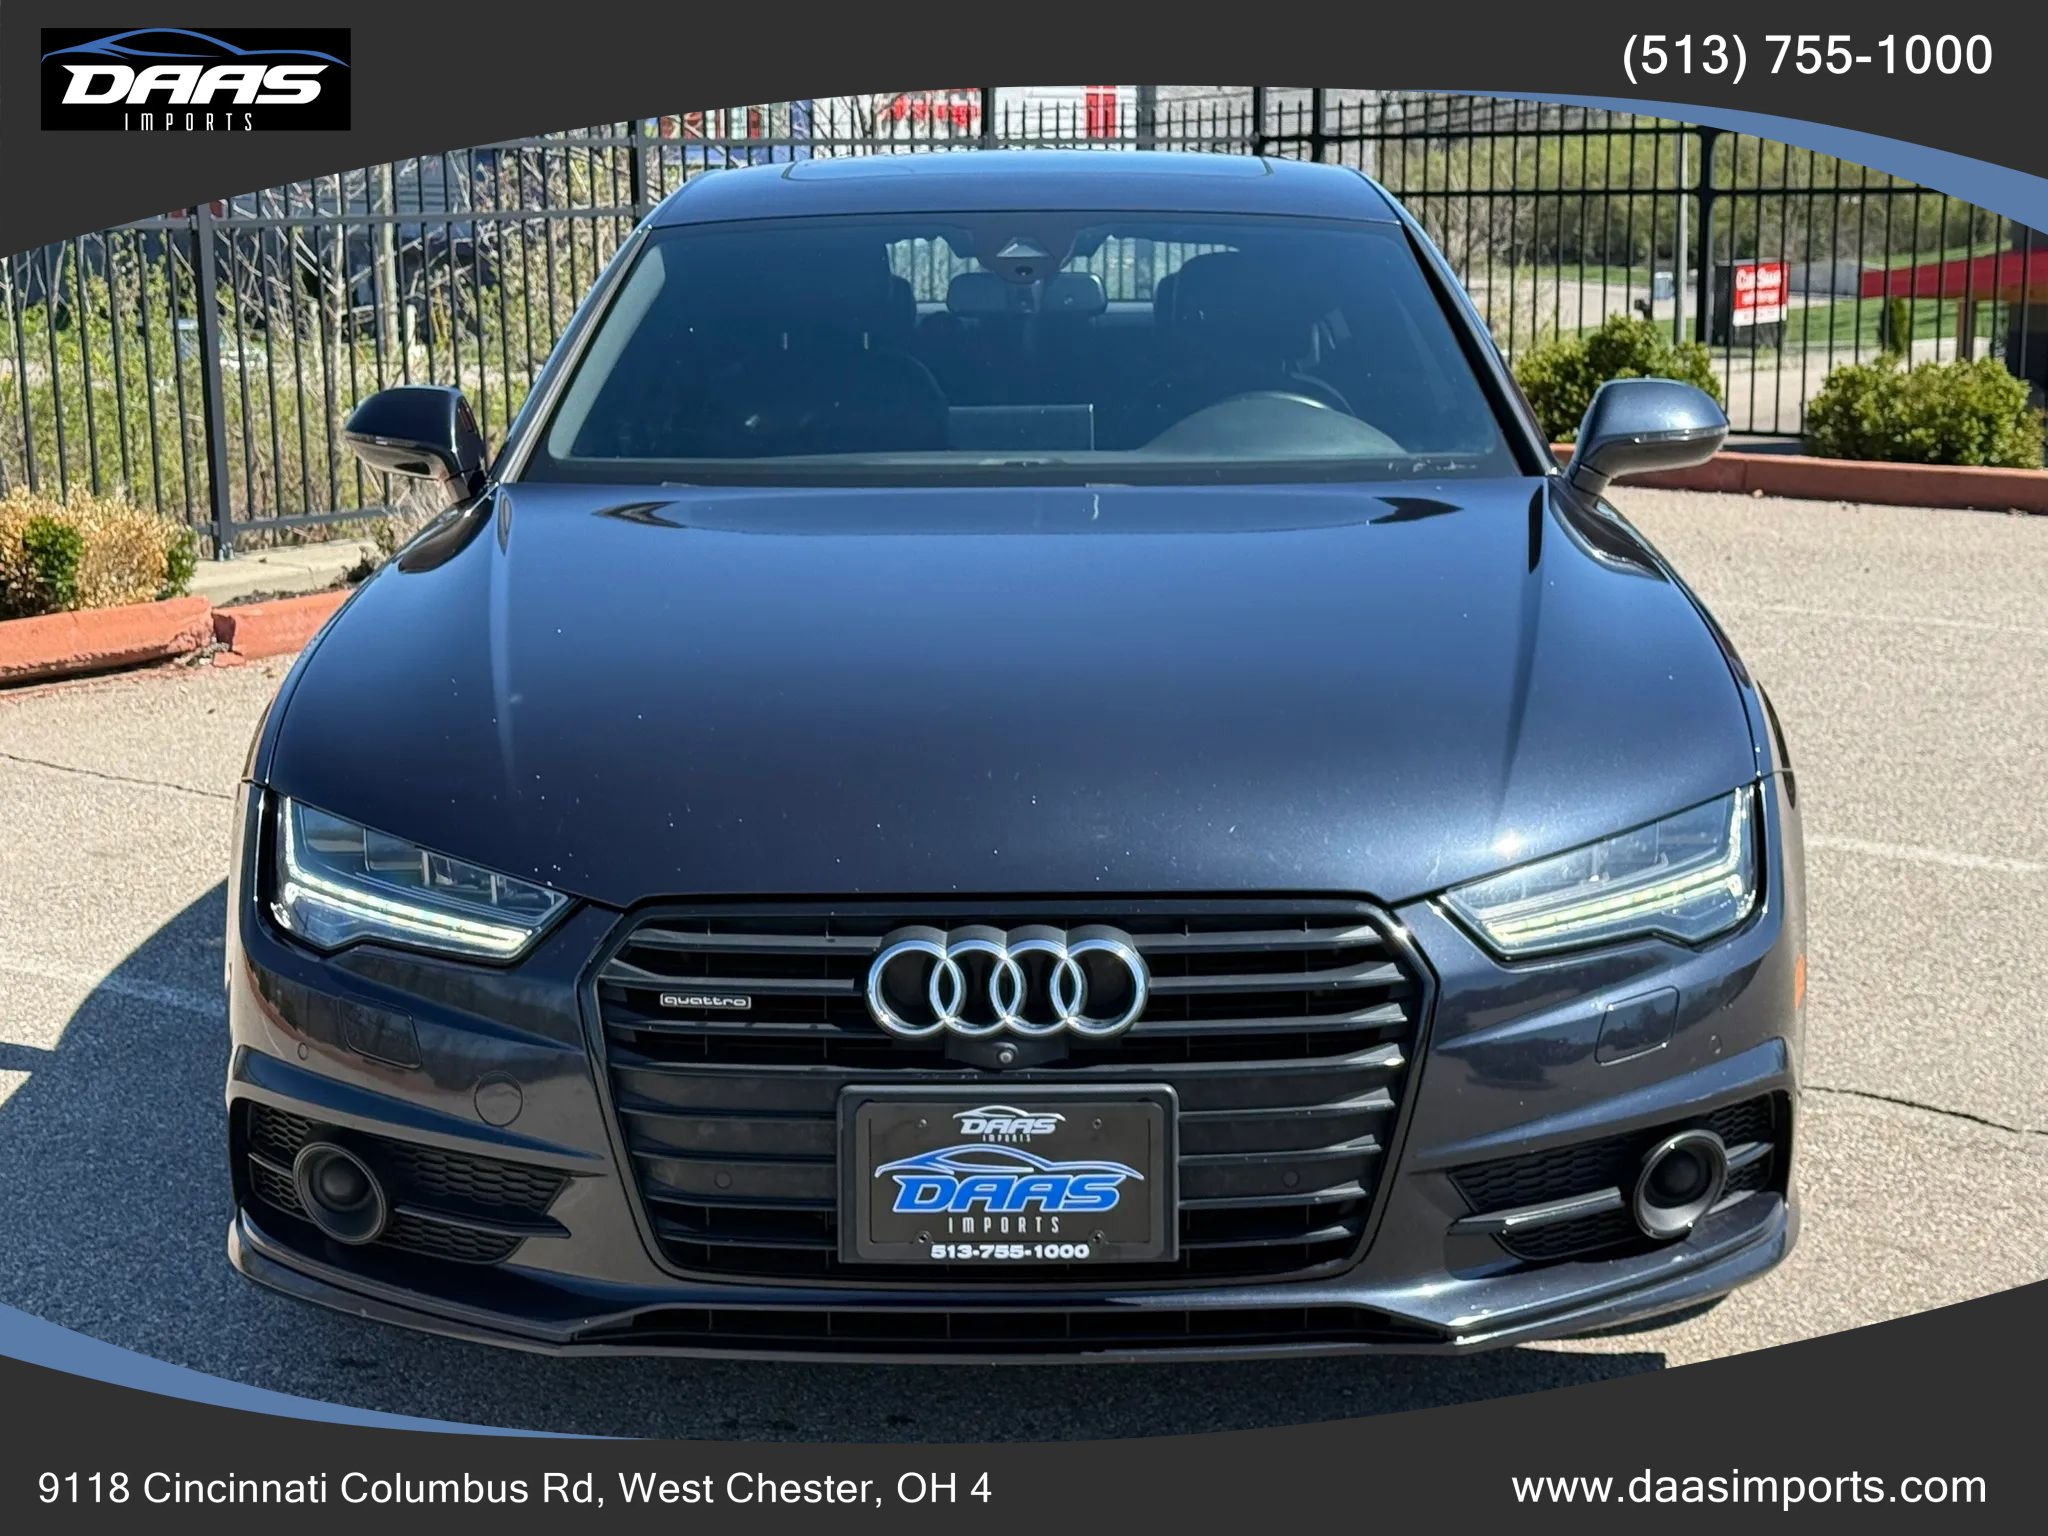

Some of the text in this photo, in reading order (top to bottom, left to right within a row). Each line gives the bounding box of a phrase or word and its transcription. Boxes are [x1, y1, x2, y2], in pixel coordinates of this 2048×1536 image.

[664, 996, 746, 1006] quattro
[959, 1118, 1056, 1134] DAAS
[982, 1134, 1031, 1142] IMPORTS
[893, 1175, 1126, 1213] DAAS
[948, 1216, 1060, 1234] IMPORTS
[931, 1243, 1090, 1260] 513-755-1000
